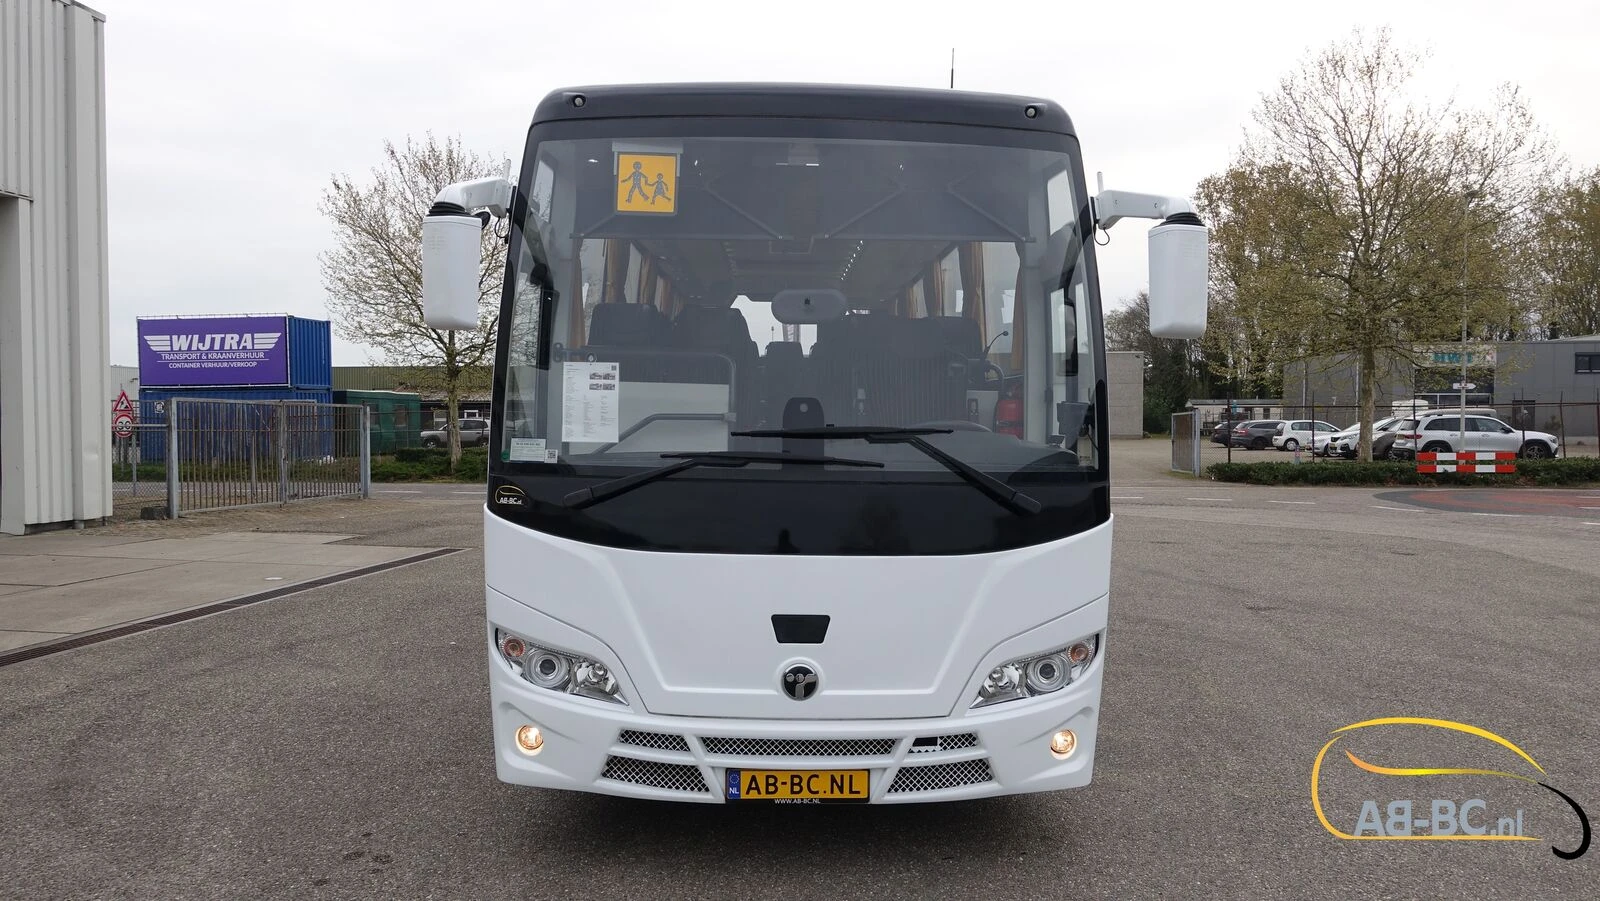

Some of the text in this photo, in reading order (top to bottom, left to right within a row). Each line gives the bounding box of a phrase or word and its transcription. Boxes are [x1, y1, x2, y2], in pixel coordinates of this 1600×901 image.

[171, 333, 253, 351] WIJTRA
[160, 352, 201, 361] TRANSPORT
[207, 351, 265, 360] KRAANVERHUUR
[168, 360, 201, 369] CONTAINER
[745, 774, 861, 795] AB-BC.NL
